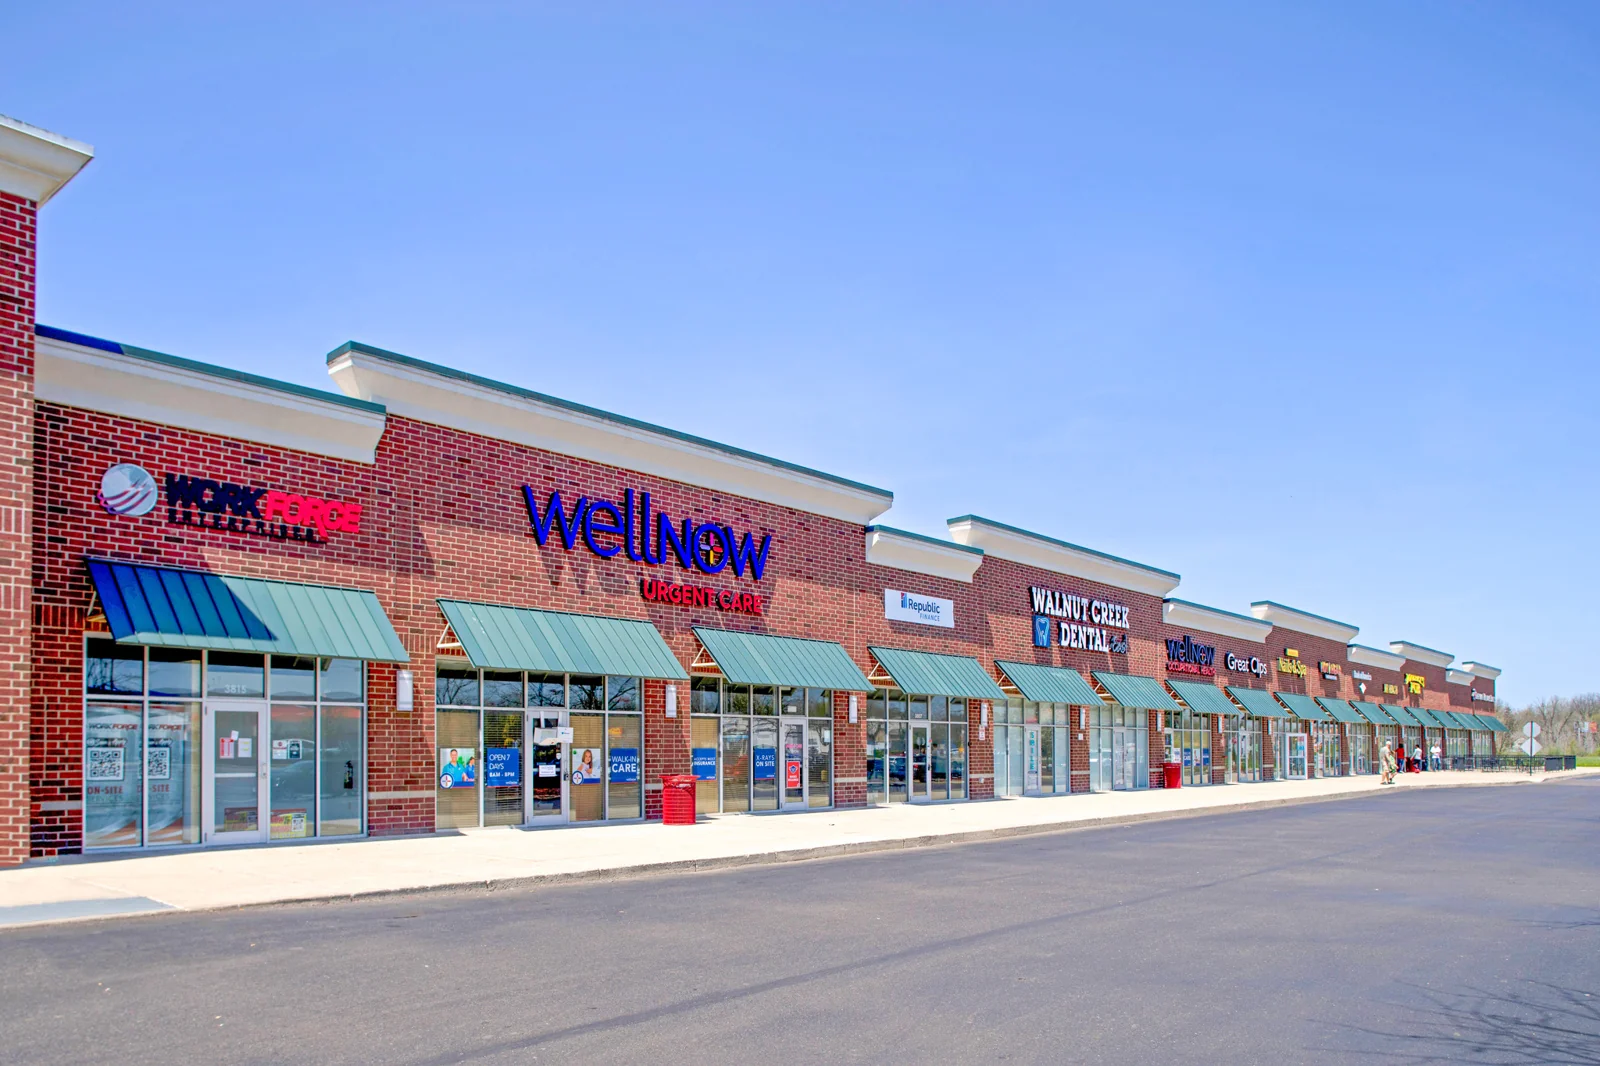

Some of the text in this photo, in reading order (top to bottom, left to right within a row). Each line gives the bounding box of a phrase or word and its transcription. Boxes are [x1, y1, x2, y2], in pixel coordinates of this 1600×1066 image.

[641, 578, 762, 613] URGENT CARE
[908, 598, 941, 614] Republic
[1029, 586, 1130, 629] WALNUT CREEK
[919, 613, 941, 622] FINANCE
[1058, 621, 1109, 653] DENTAL
[1166, 660, 1201, 675] OCCUPATIONAL
[1226, 652, 1268, 678] Great Clips
[224, 684, 247, 694] 3815
[612, 755, 637, 763] WALK-IN
[612, 763, 637, 773] CARE
[88, 785, 123, 795] ON-SITE
